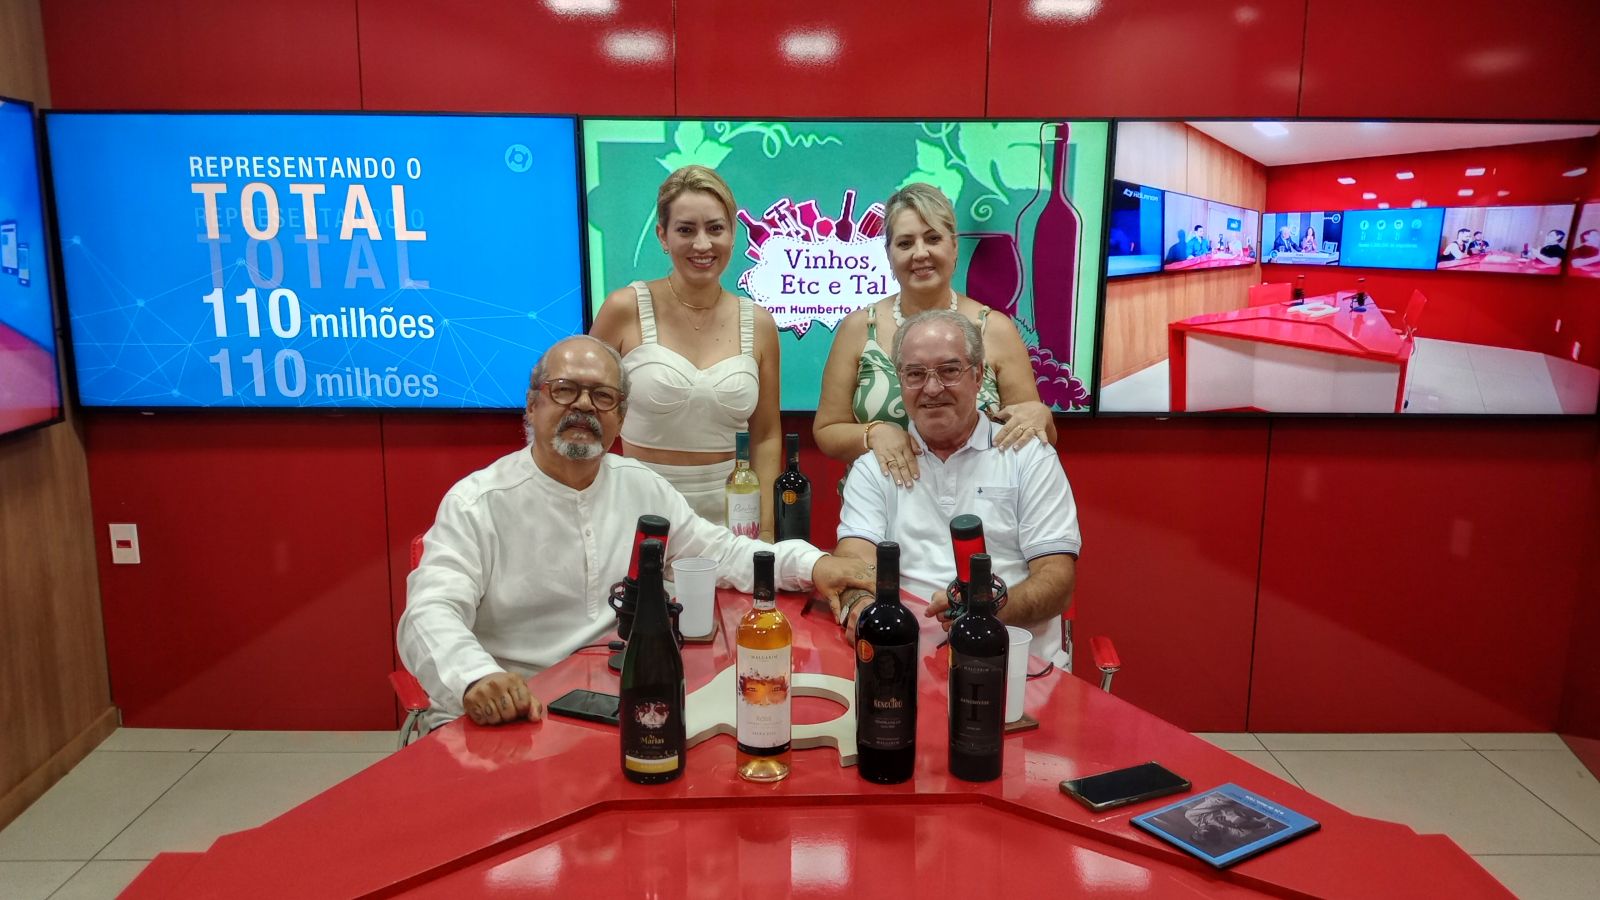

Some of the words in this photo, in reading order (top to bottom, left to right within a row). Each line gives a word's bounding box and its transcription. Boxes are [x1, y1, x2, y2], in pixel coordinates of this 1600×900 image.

[189, 156, 396, 179] REPRESENTANDO
[407, 157, 421, 179] O
[191, 182, 427, 241] TOTAL
[784, 249, 877, 272] Vinhos,
[781, 274, 820, 294] Etc
[828, 281, 841, 294] e
[849, 275, 887, 294] Tal
[202, 287, 301, 339] 110
[310, 306, 435, 339] milhões
[765, 306, 786, 314] om
[790, 304, 852, 314] Humberto
[209, 348, 307, 398] 110
[315, 366, 439, 398] milhões
